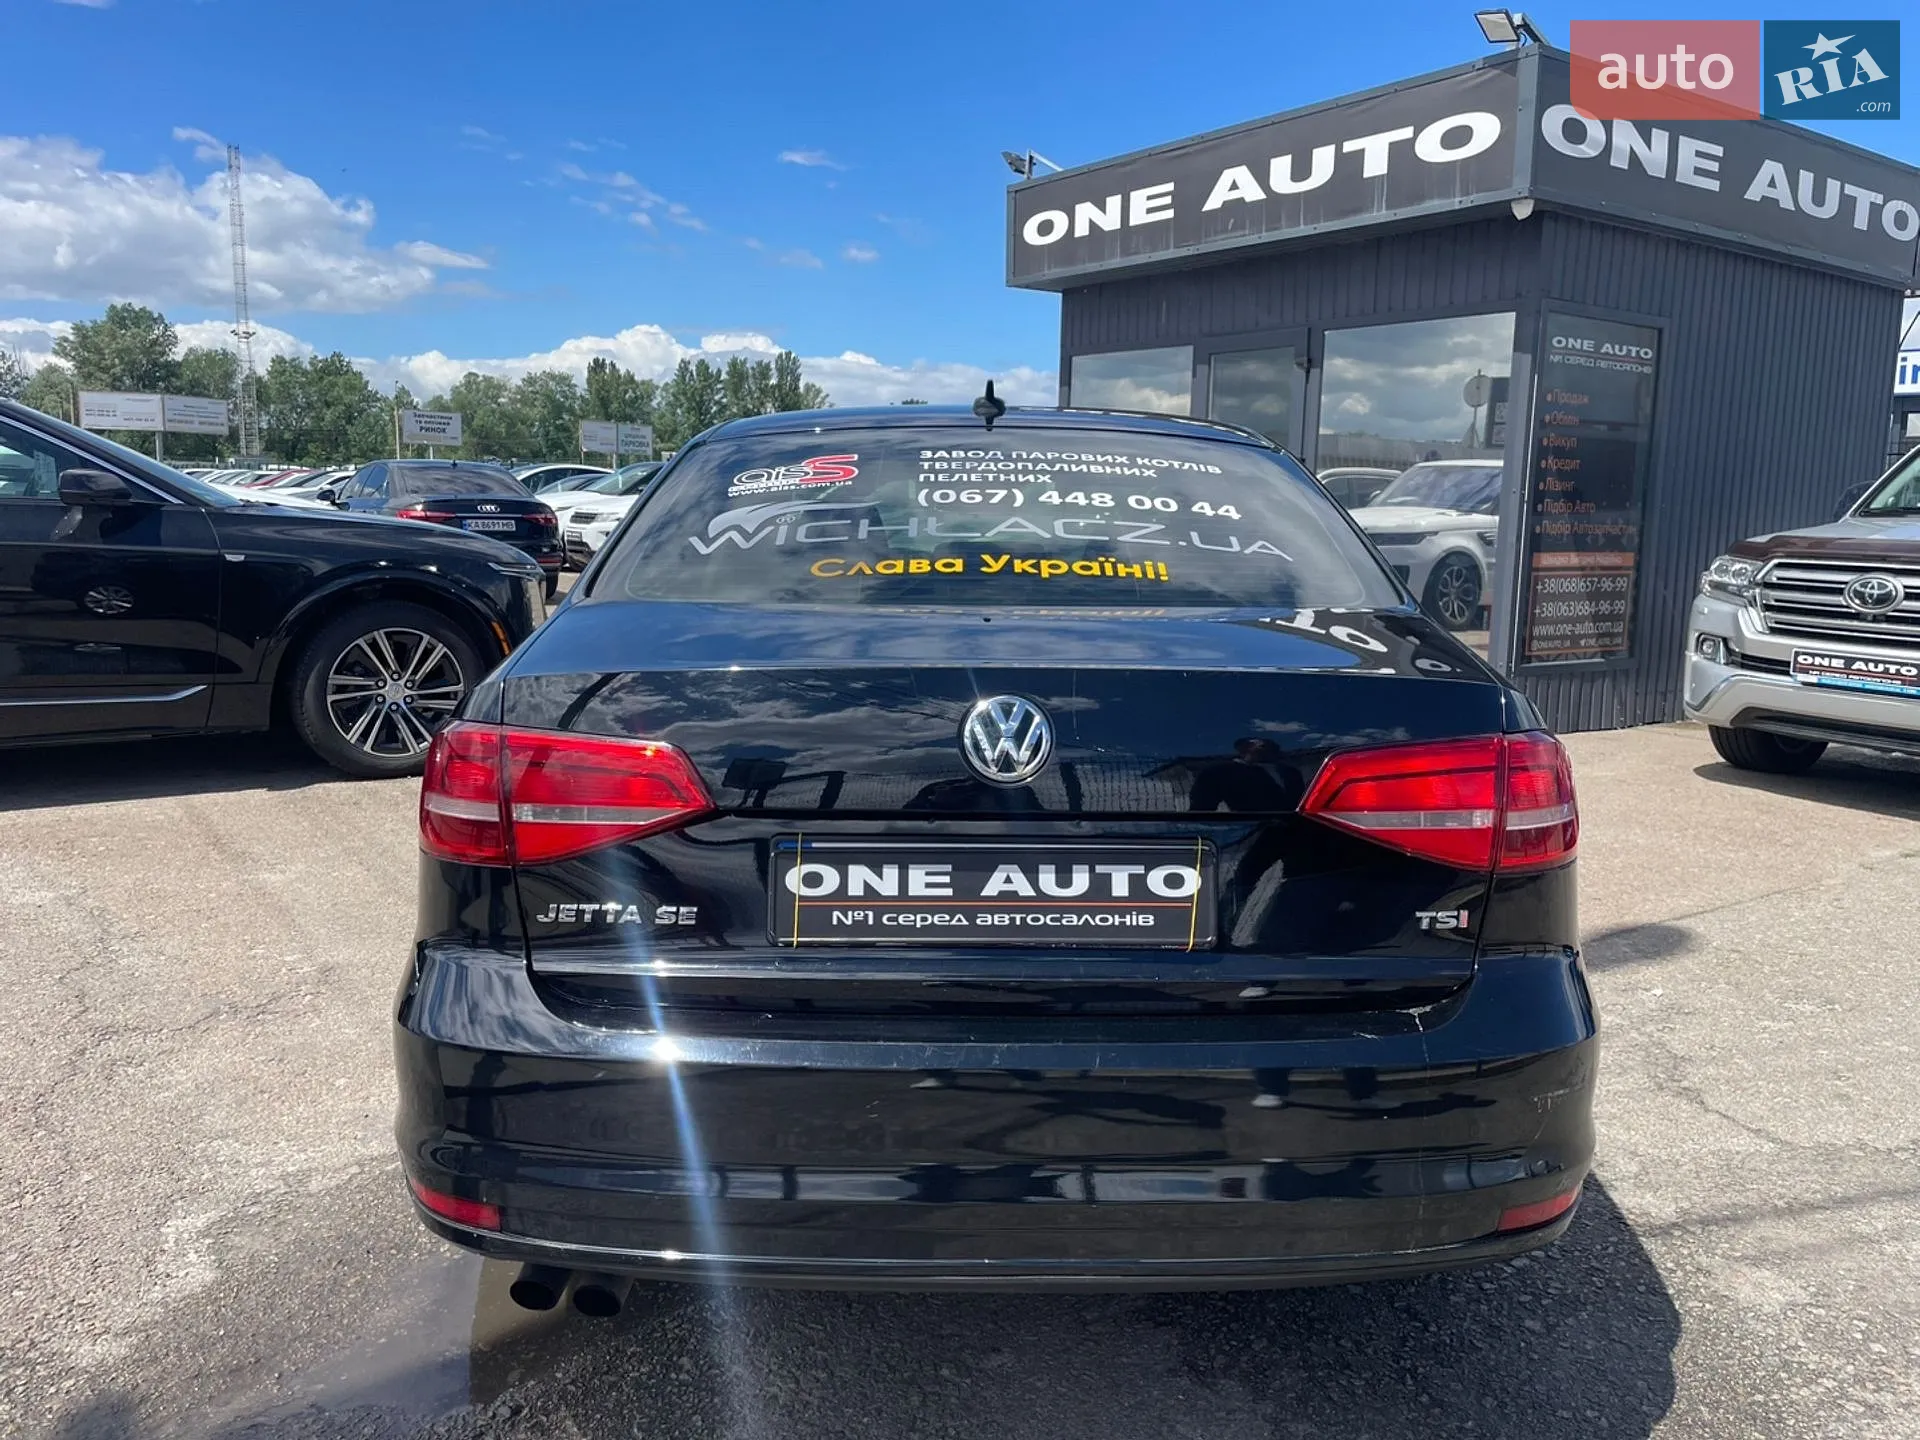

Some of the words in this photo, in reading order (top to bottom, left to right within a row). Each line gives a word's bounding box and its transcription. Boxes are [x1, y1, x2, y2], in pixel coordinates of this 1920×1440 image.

[1022, 181, 1175, 246] ONE
[1202, 111, 1502, 212] AUTO
[1541, 103, 1725, 192] ONE
[1743, 158, 1920, 242] AUTO
[1551, 336, 1595, 351] ONE
[1600, 342, 1653, 359] AUTO
[919, 450, 1005, 460] ЗАВОД
[1012, 450, 1131, 464] ПАРОВИХ
[1136, 456, 1223, 475] КОТЛІВ
[919, 461, 1158, 478] ТВЕРДОПАЛИВНИХ
[918, 473, 1053, 483] ПЕЛЕТНИХ
[917, 488, 1025, 507] (067)
[1038, 490, 1116, 508] 448
[1127, 495, 1179, 513] 00
[1191, 500, 1242, 520] 44
[809, 557, 965, 578] Слава
[979, 553, 1170, 582] Україні!
[1797, 655, 1845, 668] ONE
[1851, 660, 1918, 676] AUTO
[784, 863, 954, 898] ONE
[981, 864, 1203, 898] AUTO
[536, 901, 642, 924] JETTA
[654, 904, 698, 926] SE
[832, 910, 874, 926] №1
[881, 913, 967, 928] серед
[976, 911, 1155, 927] автосалонів
[1415, 909, 1469, 930] TSI
